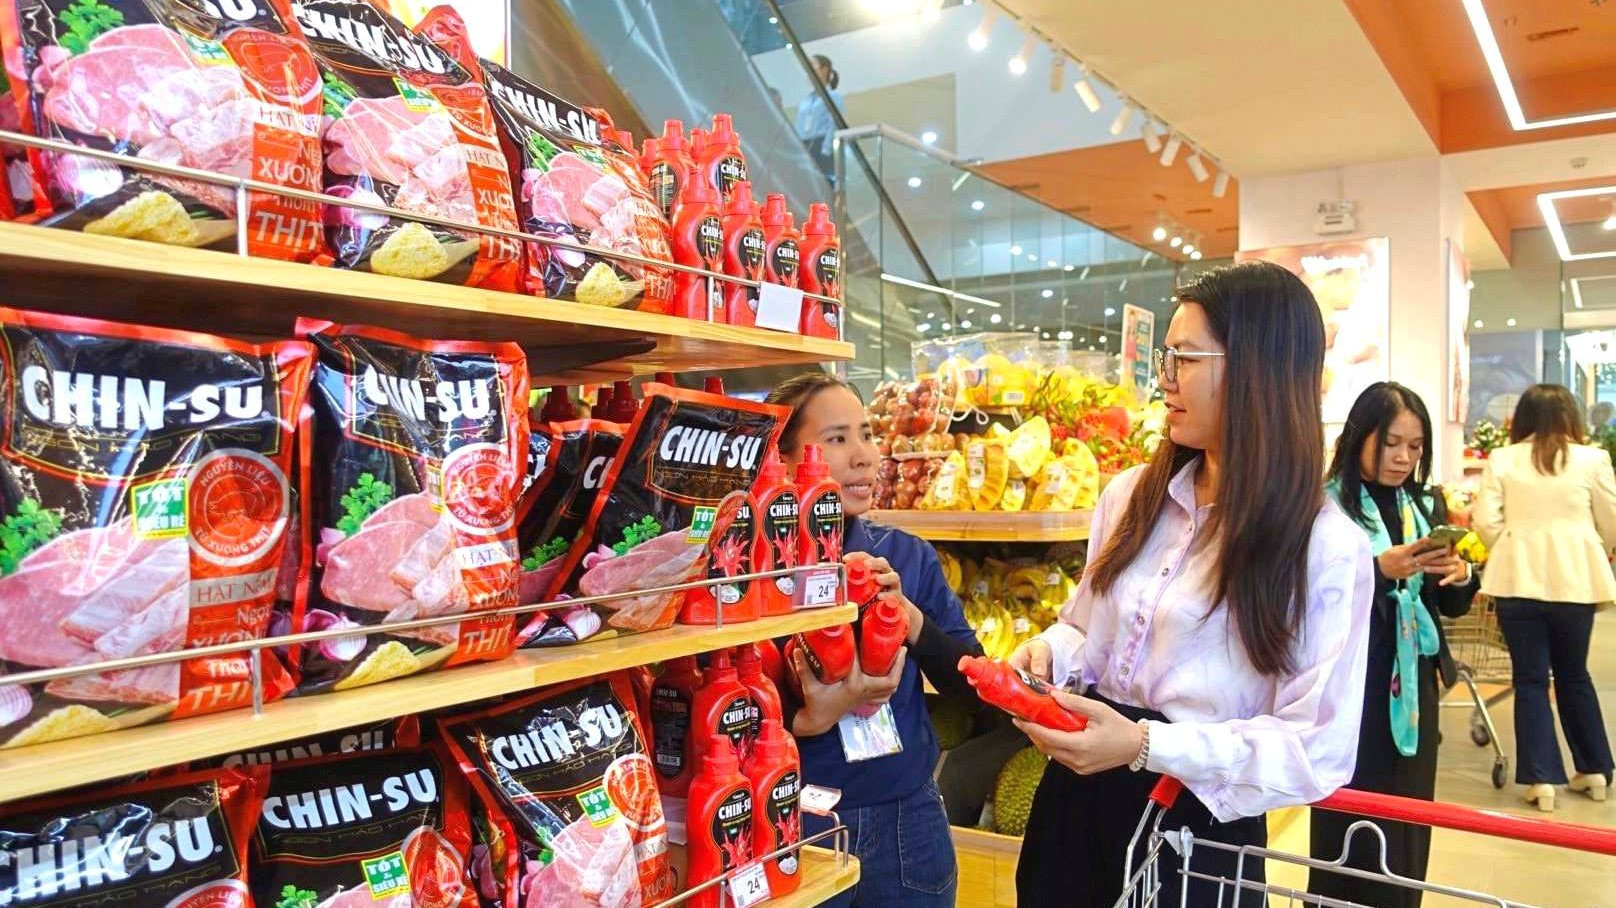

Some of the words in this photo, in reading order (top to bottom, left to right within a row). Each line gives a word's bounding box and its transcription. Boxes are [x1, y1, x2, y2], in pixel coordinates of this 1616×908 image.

[490, 76, 602, 146] CHIN-SU
[21, 364, 264, 431] CHIN-SU
[659, 424, 763, 471] CHIN-SU
[818, 583, 830, 598] 24
[491, 703, 623, 771] CHIN-SU
[262, 768, 437, 829] CHIN-SU
[747, 876, 761, 895] 24
